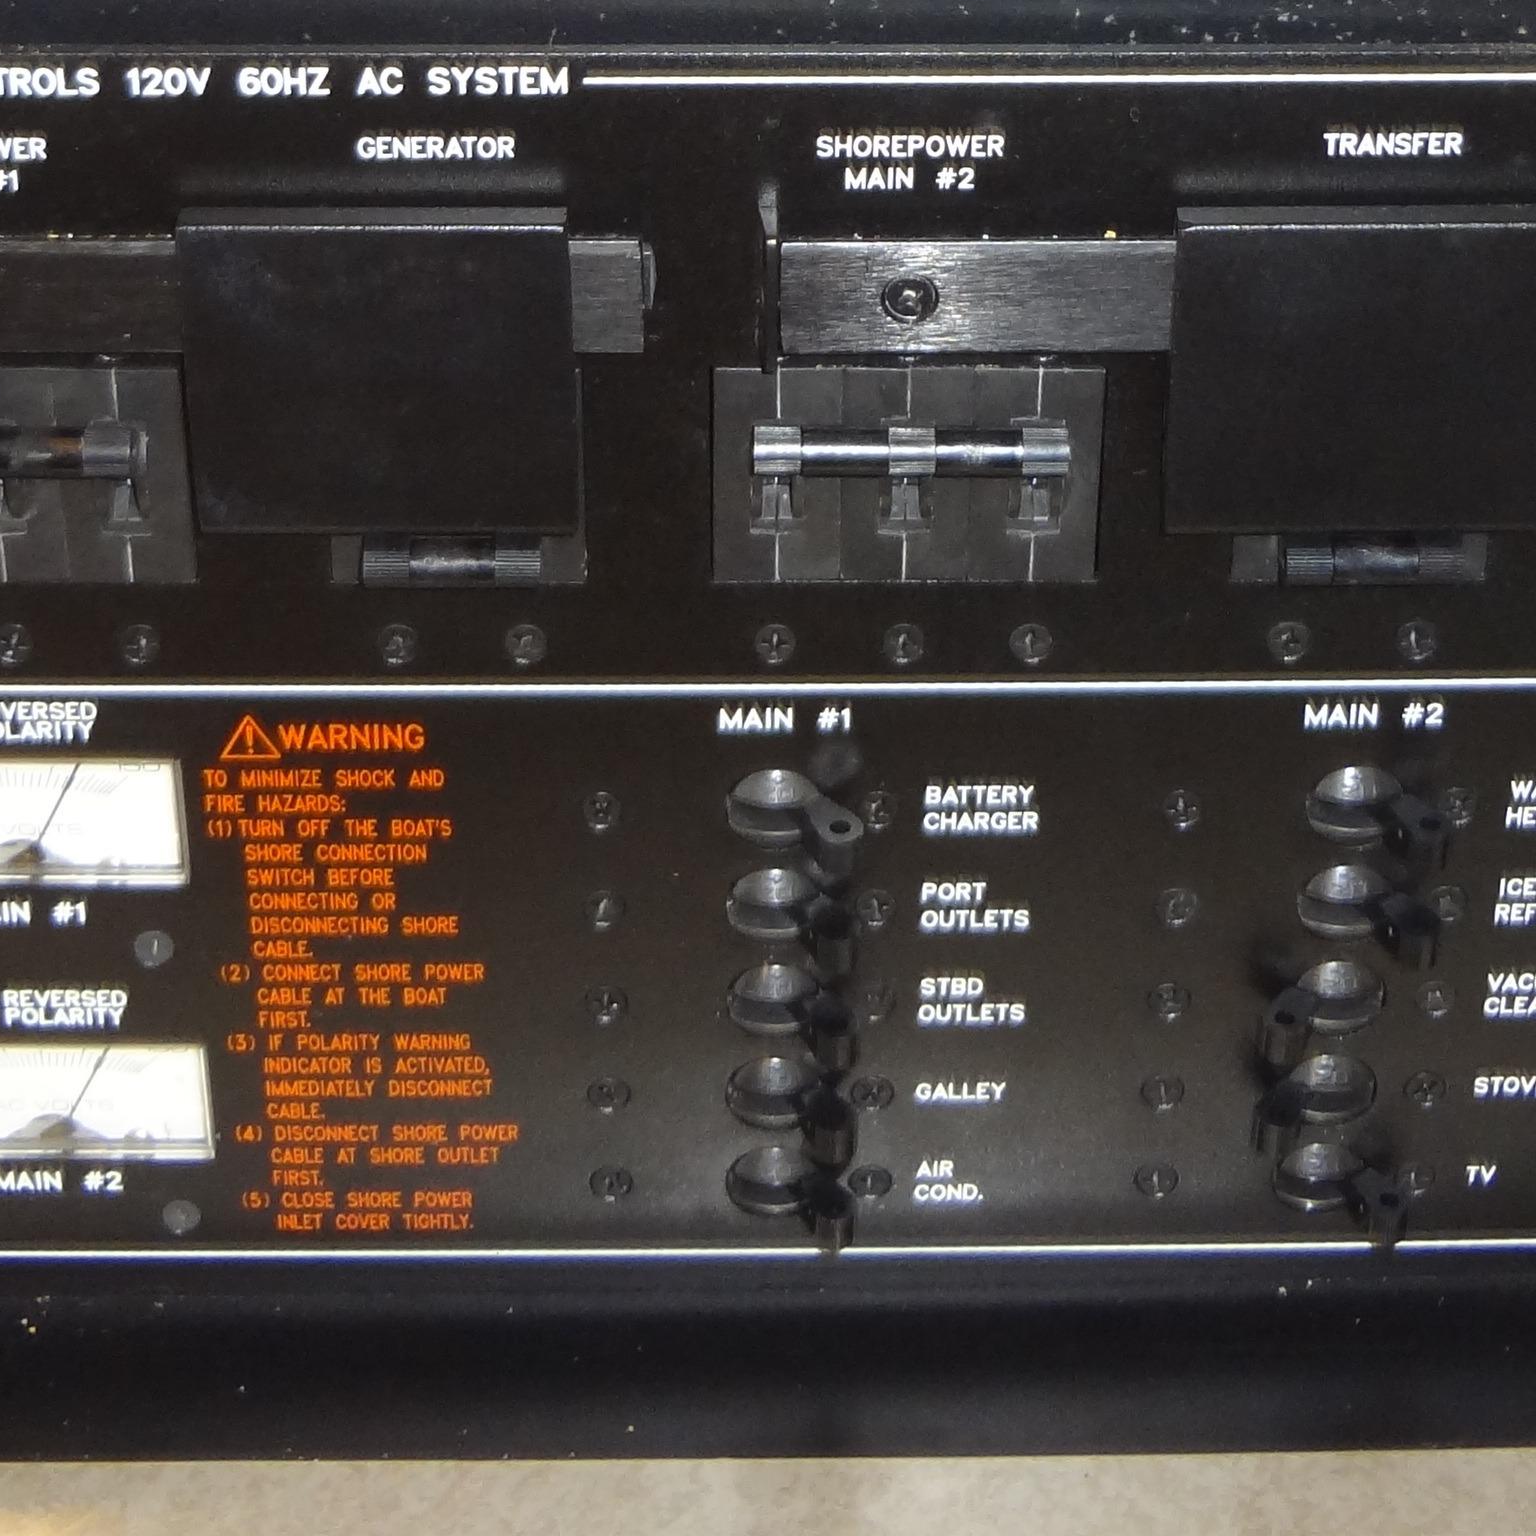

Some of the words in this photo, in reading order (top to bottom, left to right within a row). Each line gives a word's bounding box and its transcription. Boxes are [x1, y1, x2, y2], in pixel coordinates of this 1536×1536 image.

[125, 66, 212, 97] 120V
[237, 66, 331, 97] 60HZ
[356, 66, 404, 96] AC
[427, 65, 569, 96] SYSTEM
[356, 135, 515, 160] GENERATOR
[816, 134, 1005, 158] SHOREPOWER
[1323, 131, 1464, 157] TRANSFER
[844, 166, 915, 190] MAIN
[935, 166, 975, 190] #2
[718, 707, 794, 732] MAIN
[817, 706, 851, 731] #1
[1304, 703, 1379, 728] MAIN
[1401, 702, 1444, 727] #2
[278, 724, 427, 751] WARNING
[203, 769, 230, 789] TO
[238, 769, 324, 790] MINIMIZE
[334, 770, 396, 788] SHOCK
[408, 768, 446, 788] AND
[924, 784, 1034, 807] BATTERY
[923, 811, 1039, 833] CHARGER
[244, 843, 303, 863] SHORE
[315, 843, 429, 864] CONNECTION
[246, 868, 317, 886] SWITCH
[326, 867, 394, 888] BEFORE
[250, 892, 360, 912] CONNECTING
[371, 892, 398, 910] OR
[921, 881, 987, 904] PORT
[51, 901, 87, 925] #1
[920, 908, 1030, 931] OUTLETS
[250, 916, 390, 935] DISCONNECTING
[402, 917, 458, 934] SHORE
[920, 976, 984, 998] STBD
[1, 989, 129, 1008] REVERSED
[3, 1007, 124, 1027] POLARITY
[917, 1003, 1025, 1024] OUTLETS
[264, 1079, 374, 1098] IMMEDIATELY
[388, 1079, 492, 1096] DISCONNECT
[914, 1081, 1006, 1103] GALLEY
[915, 1159, 954, 1179] AIR
[1466, 1164, 1497, 1185] TV
[83, 1170, 124, 1192] #2
[913, 1183, 984, 1202] COND.
